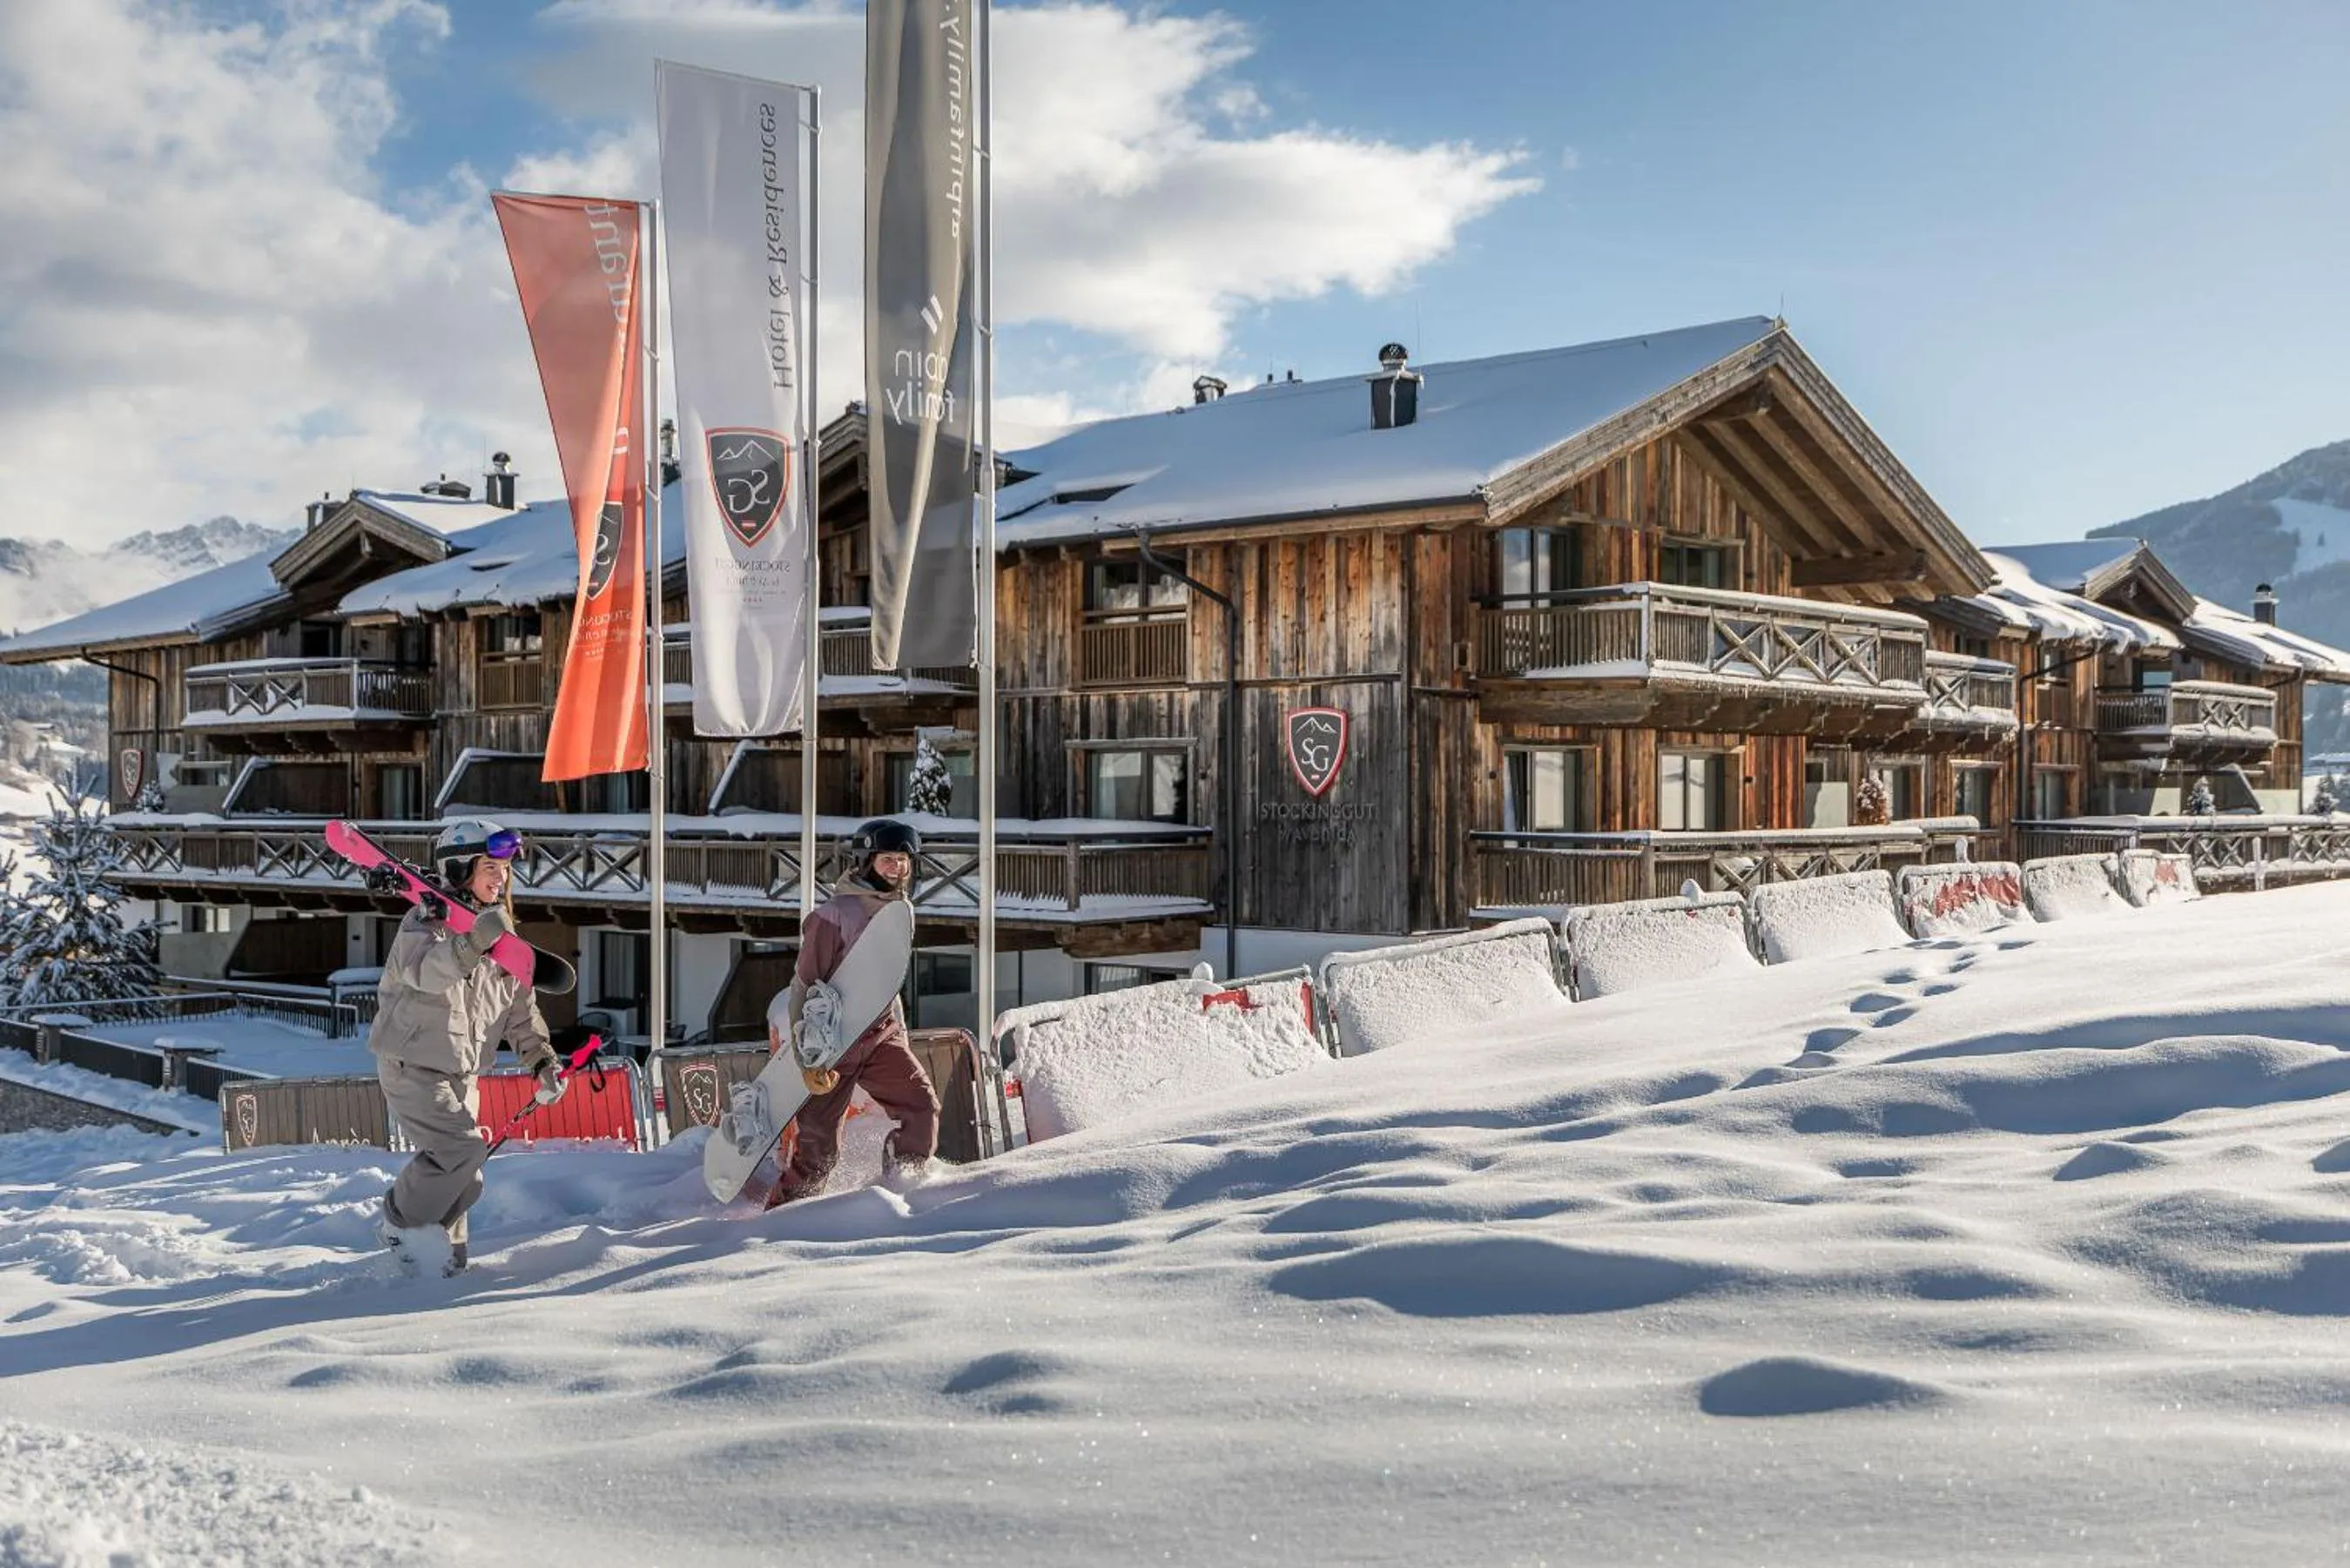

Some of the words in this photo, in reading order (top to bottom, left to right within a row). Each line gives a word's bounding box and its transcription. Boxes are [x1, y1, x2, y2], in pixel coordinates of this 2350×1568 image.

[1301, 737, 1330, 771] SG
[1260, 802, 1377, 819] STOCKINGGUT
[693, 1087, 712, 1114] SG
